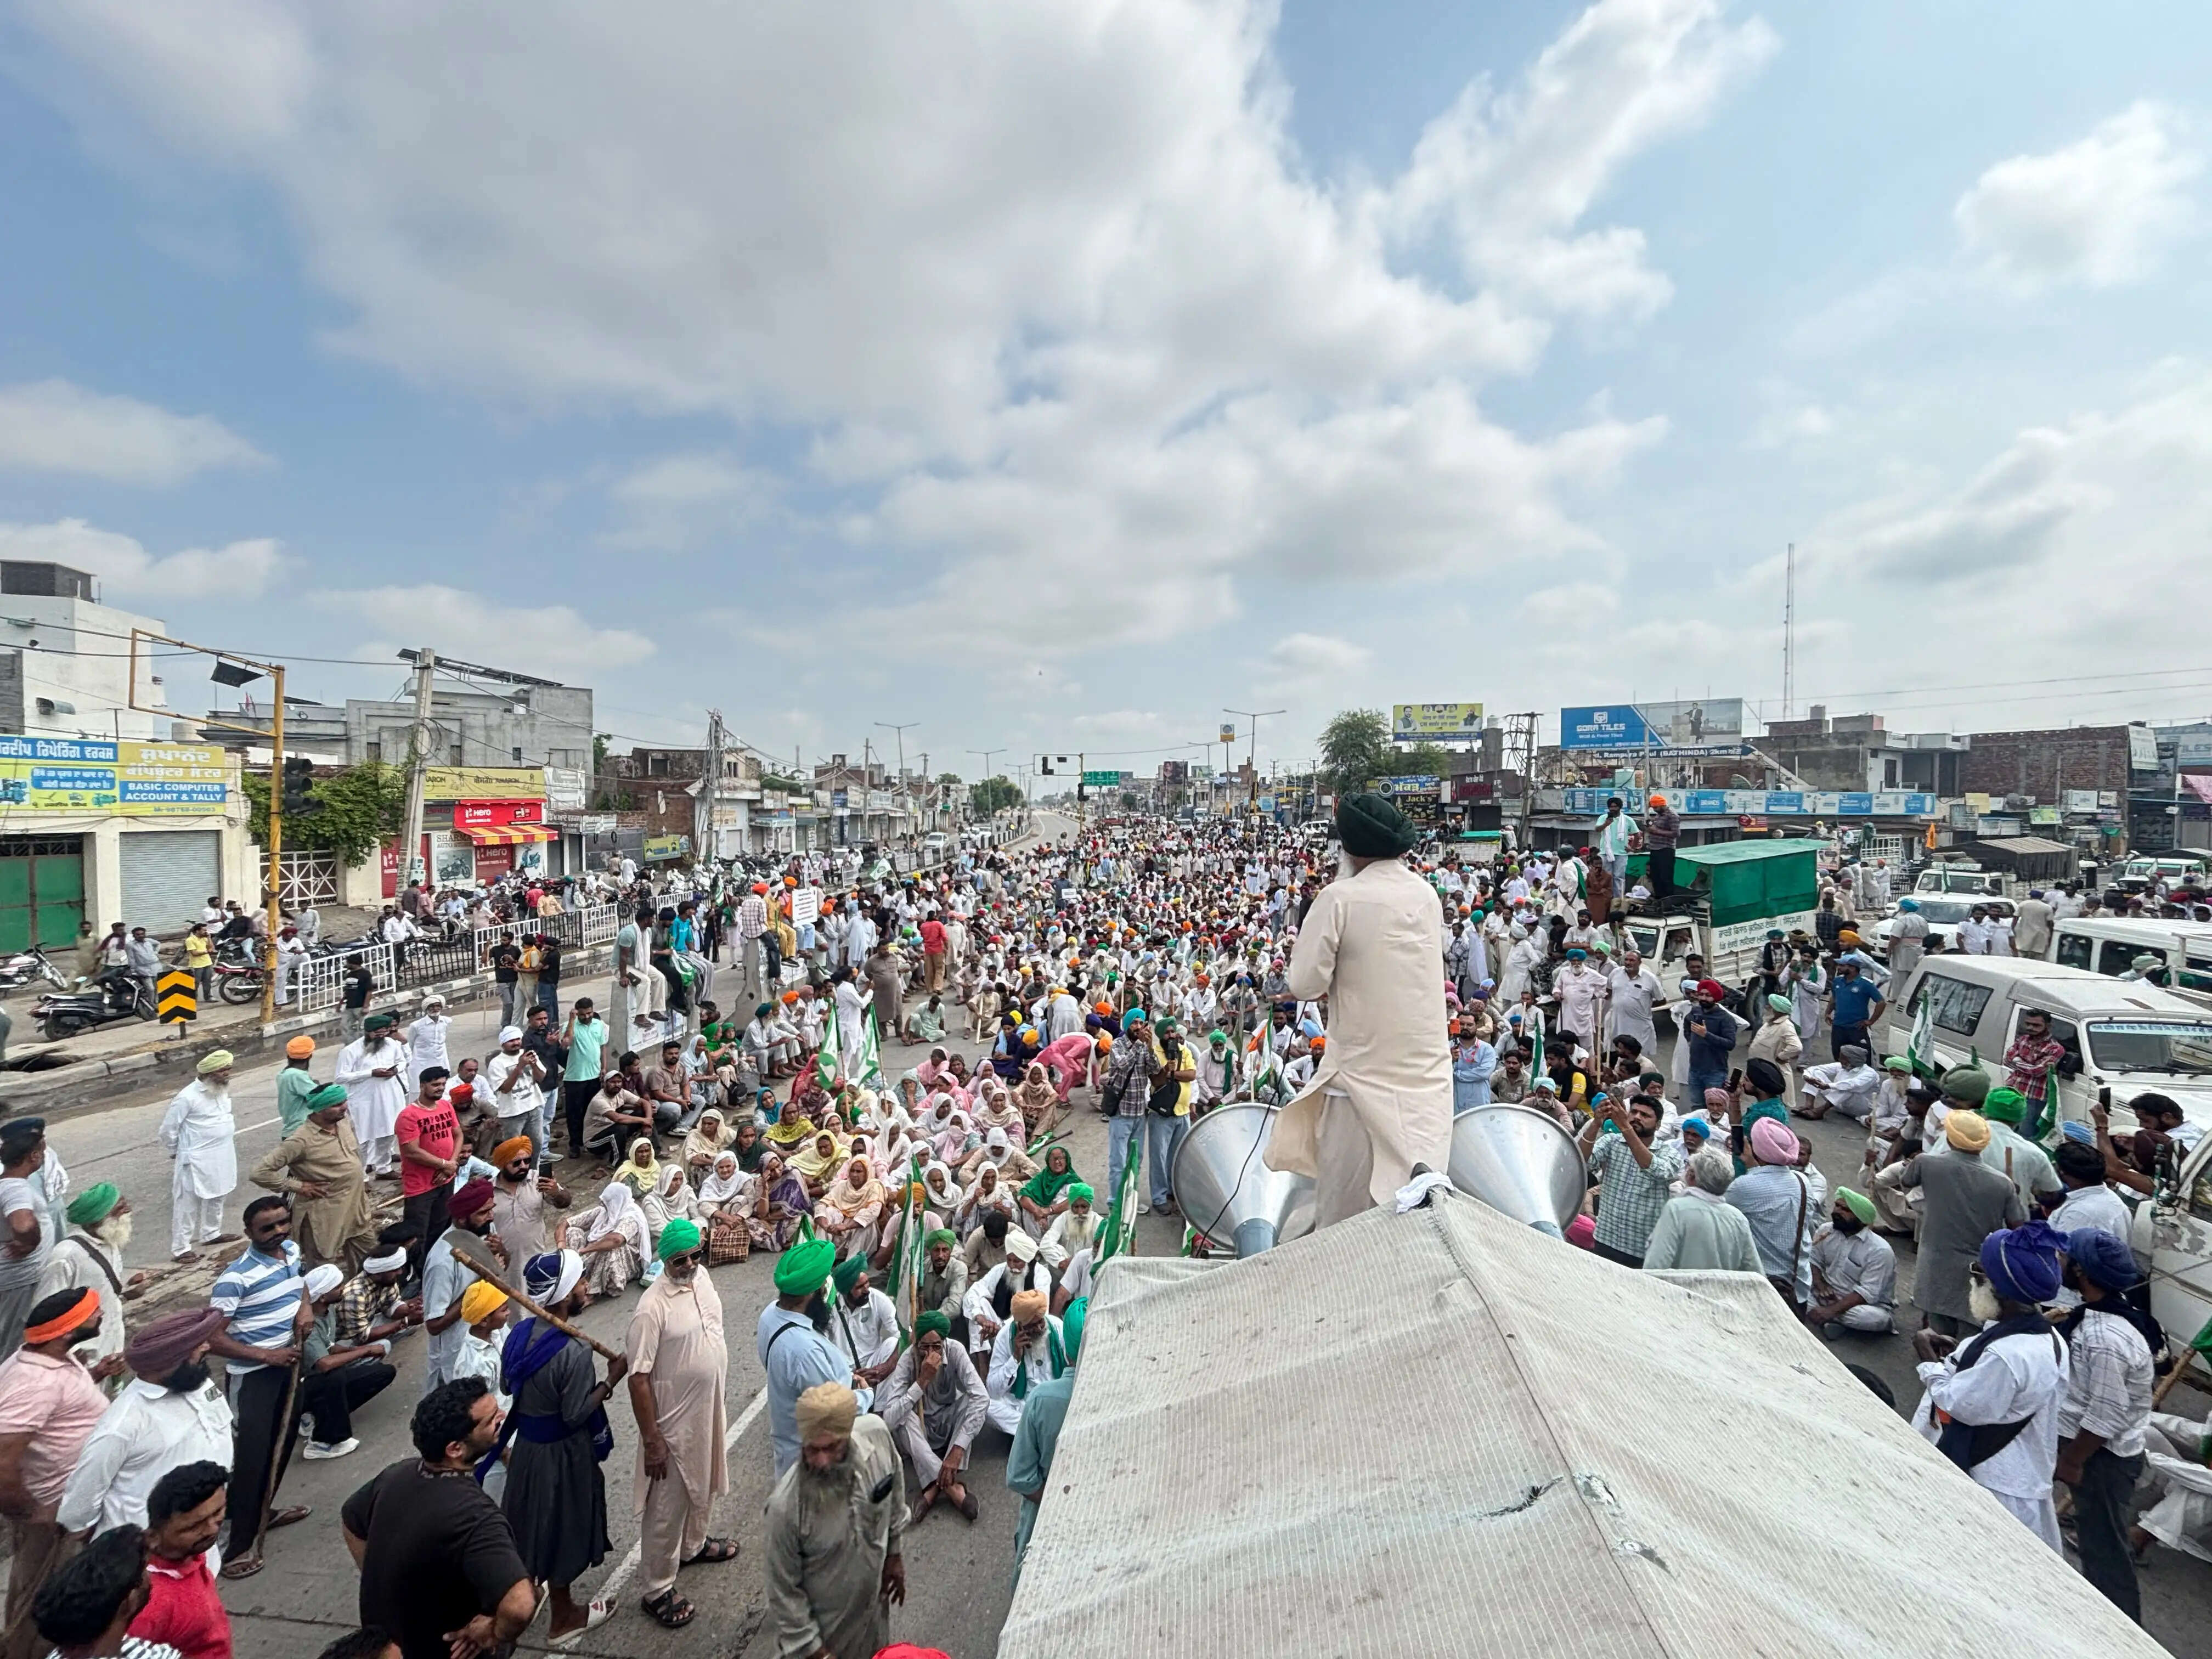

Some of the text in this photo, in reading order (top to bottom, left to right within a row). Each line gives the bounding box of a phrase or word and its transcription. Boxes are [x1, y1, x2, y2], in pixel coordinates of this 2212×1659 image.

[0, 739, 31, 757] ਰਦੀਪ
[1660, 748, 1707, 757] (BATHINDA)
[165, 783, 221, 792] COMPUTER
